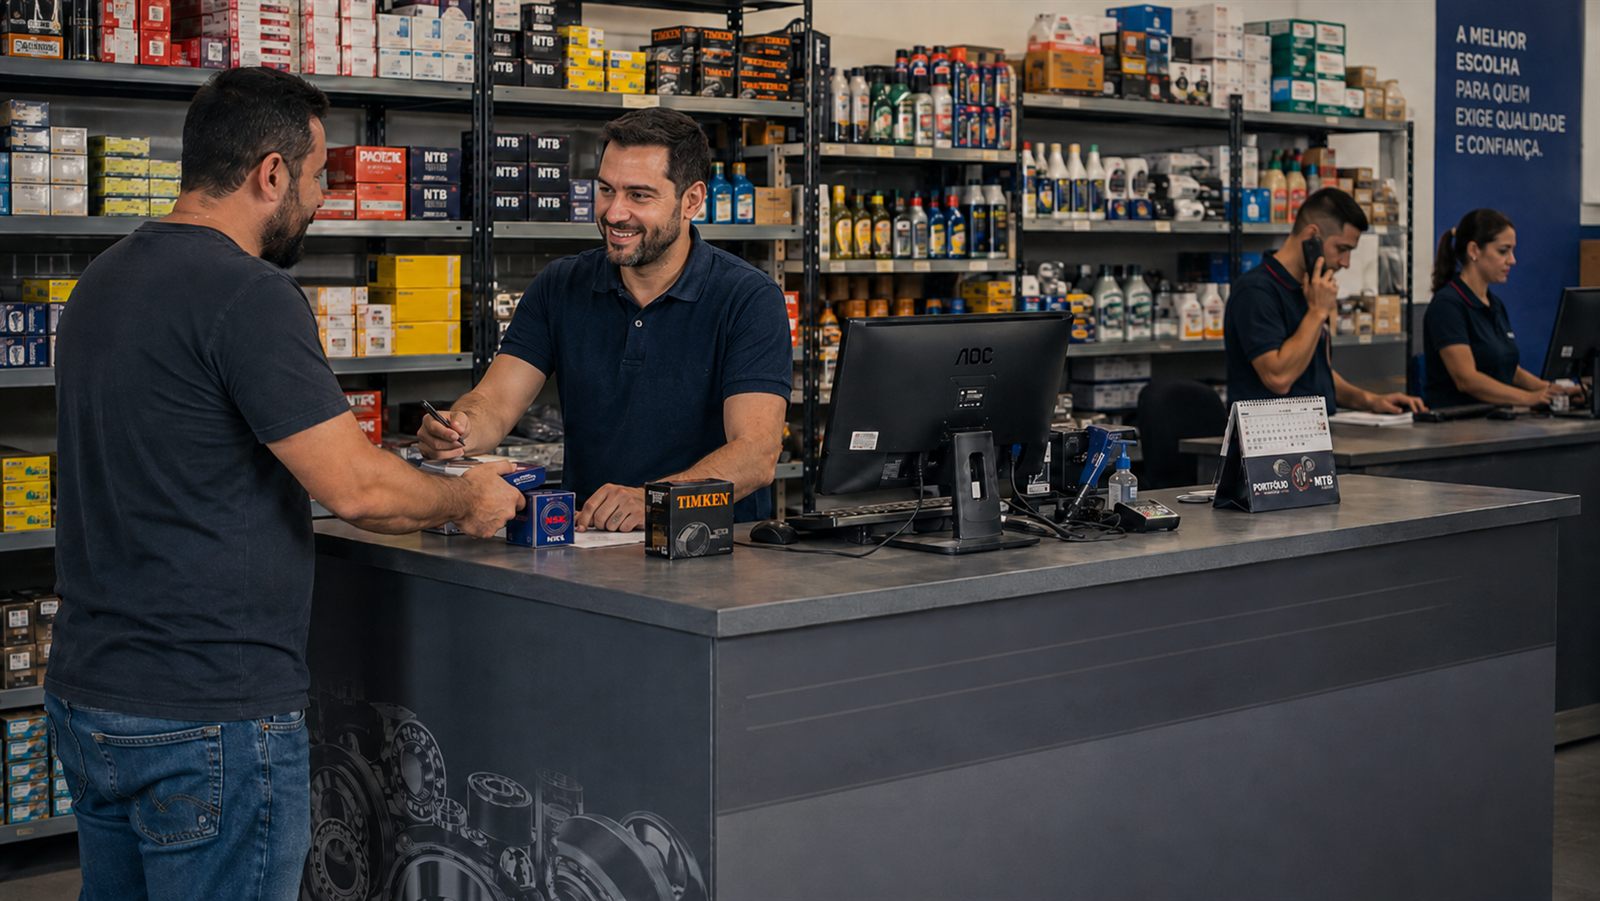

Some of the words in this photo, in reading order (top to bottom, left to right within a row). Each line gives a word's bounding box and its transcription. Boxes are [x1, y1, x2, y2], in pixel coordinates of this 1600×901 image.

[534, 5, 555, 15] NTB
[532, 35, 555, 47] NTB
[1456, 25, 1467, 44] A
[1470, 27, 1527, 50] MELHOR
[532, 63, 555, 75] NTB
[1456, 52, 1521, 76] ESCOLHA
[1456, 80, 1491, 101] PARA
[1493, 83, 1530, 104] QUEM
[1456, 107, 1494, 127] EXIGE
[1496, 110, 1566, 133] QUALIDADE
[496, 137, 519, 148] NTB
[537, 138, 560, 149] NTB
[1456, 135, 1464, 153] E
[1467, 135, 1544, 160] CONFIANÇA.
[424, 151, 448, 163] NTB
[496, 167, 519, 178] NTB
[537, 168, 560, 179] NTB
[424, 189, 448, 200] NTB
[496, 197, 519, 208] NTB
[537, 198, 560, 209] NTB
[955, 347, 993, 366] AOC
[1252, 480, 1289, 492] PORTFÓLIO
[677, 492, 730, 510] TIMKEN
